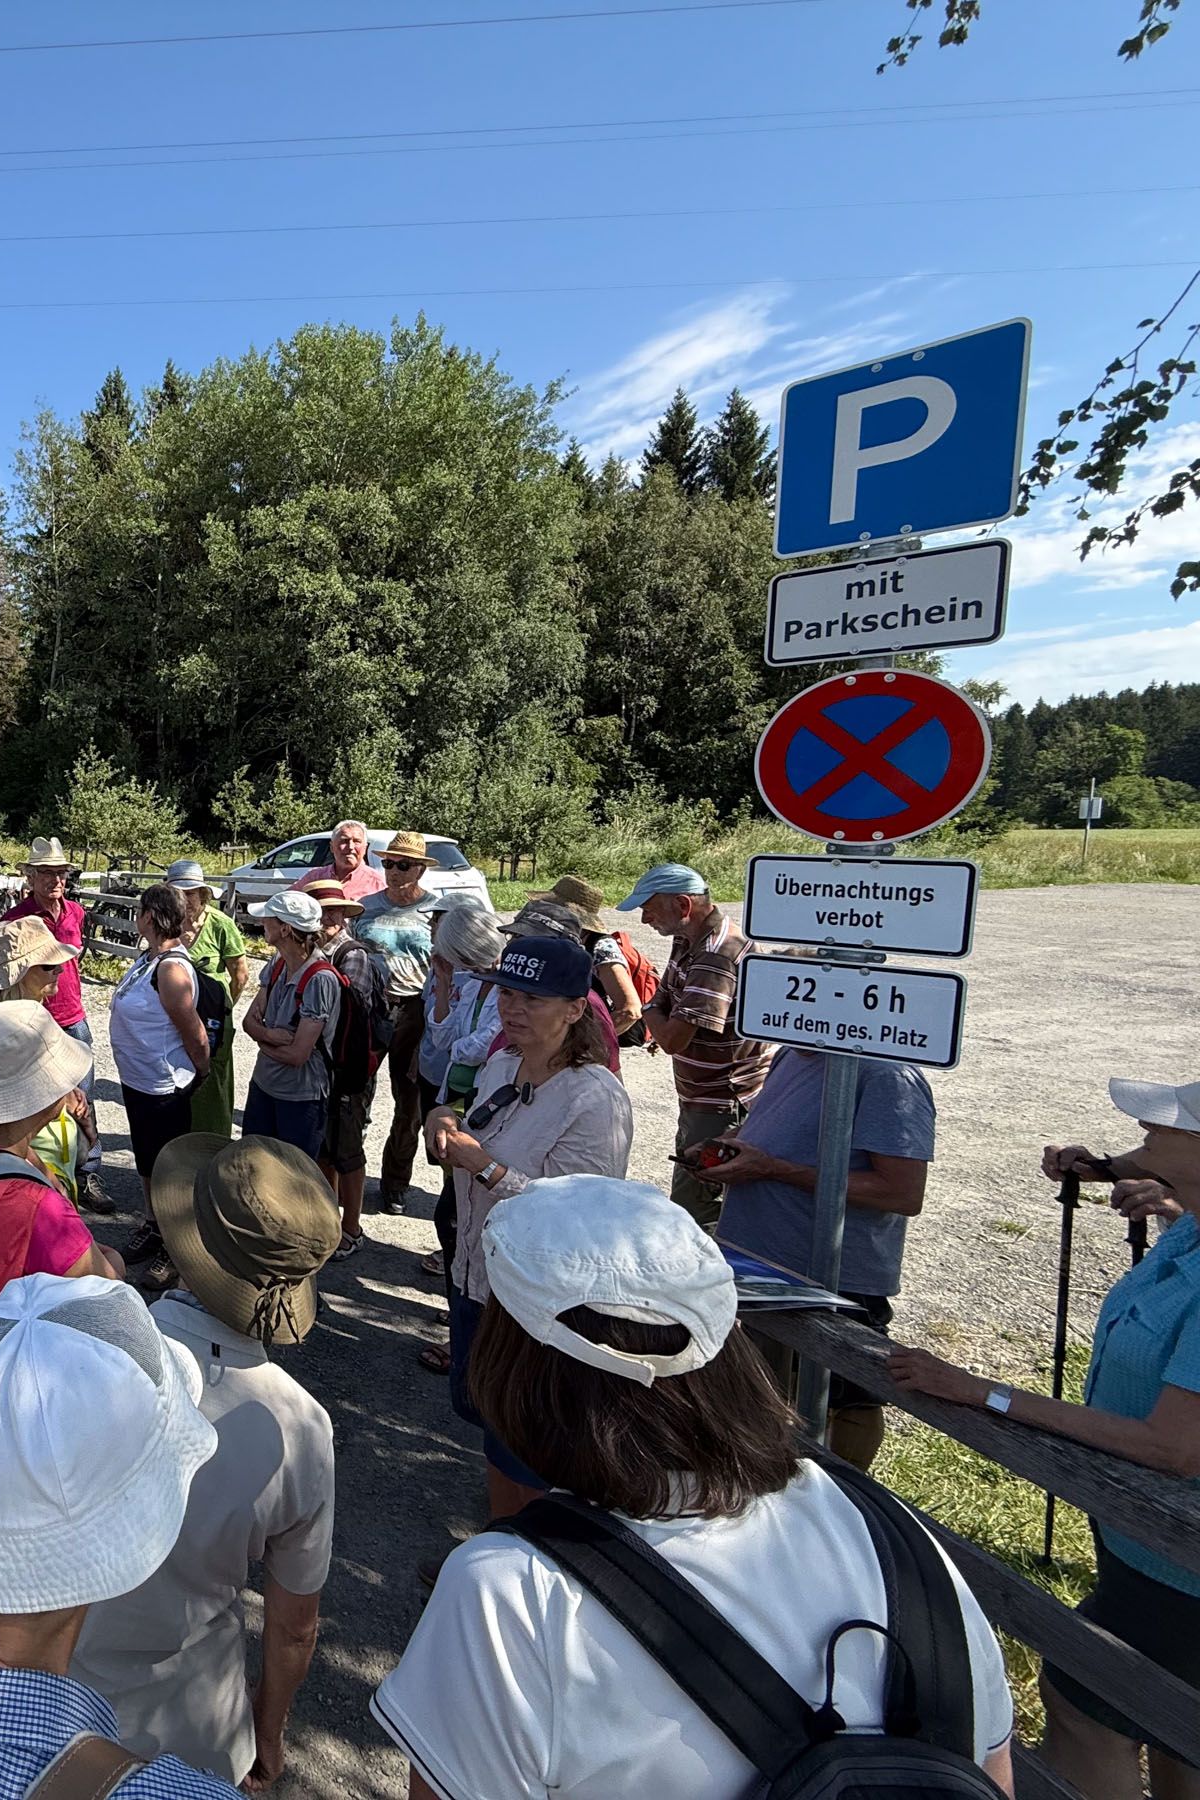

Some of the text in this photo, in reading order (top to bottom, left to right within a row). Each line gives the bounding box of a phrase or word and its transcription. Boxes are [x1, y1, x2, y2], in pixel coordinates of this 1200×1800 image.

[829, 375, 958, 525] P
[845, 569, 905, 600] mit
[783, 597, 983, 643] Parkschein
[774, 873, 935, 906] Übernachtungs
[815, 908, 884, 929] verbot
[501, 962, 536, 979] WALD
[504, 953, 540, 969] BERG
[785, 975, 817, 1003] 22
[863, 984, 879, 1010] 6
[889, 985, 906, 1014] h
[761, 1011, 928, 1049] auf dem ges. Platz
